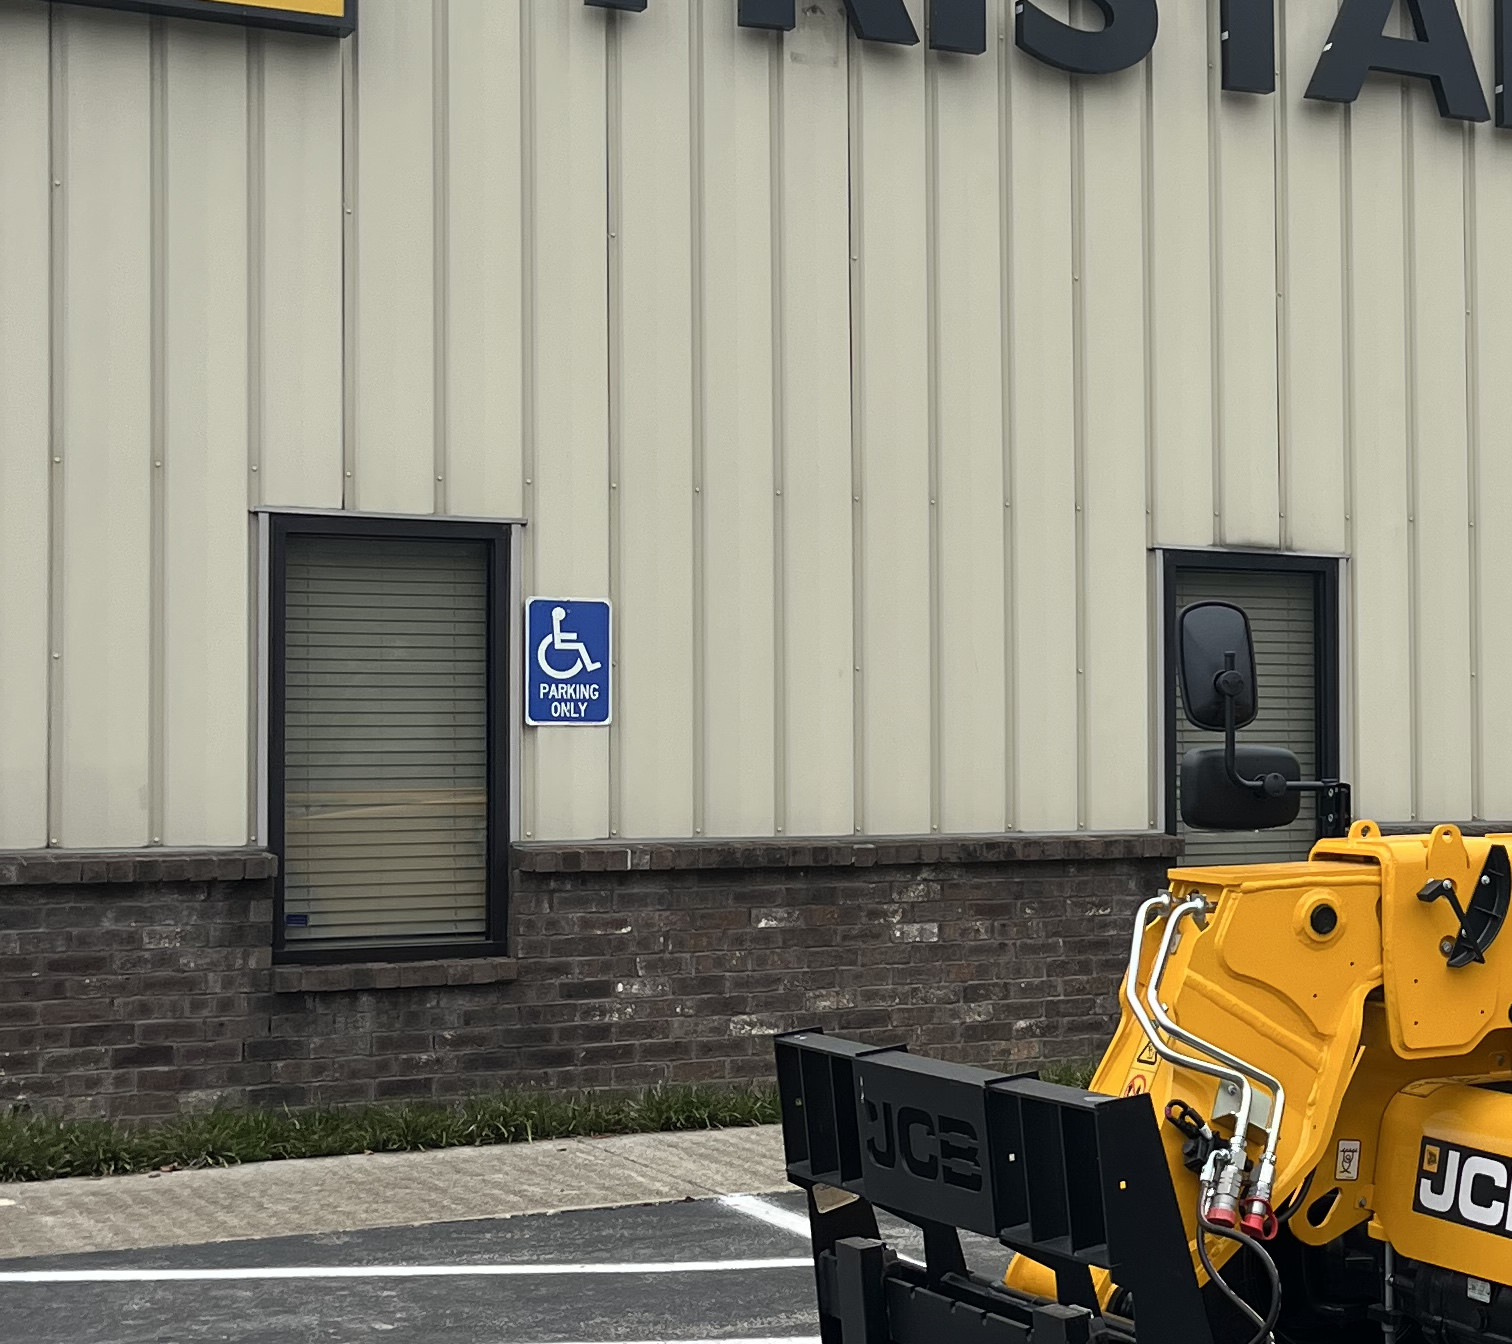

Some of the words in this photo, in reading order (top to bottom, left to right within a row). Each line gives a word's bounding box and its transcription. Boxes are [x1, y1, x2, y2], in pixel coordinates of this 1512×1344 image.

[539, 683, 599, 700] PARKING
[551, 702, 588, 718] ONLY
[866, 1100, 983, 1193] JCB
